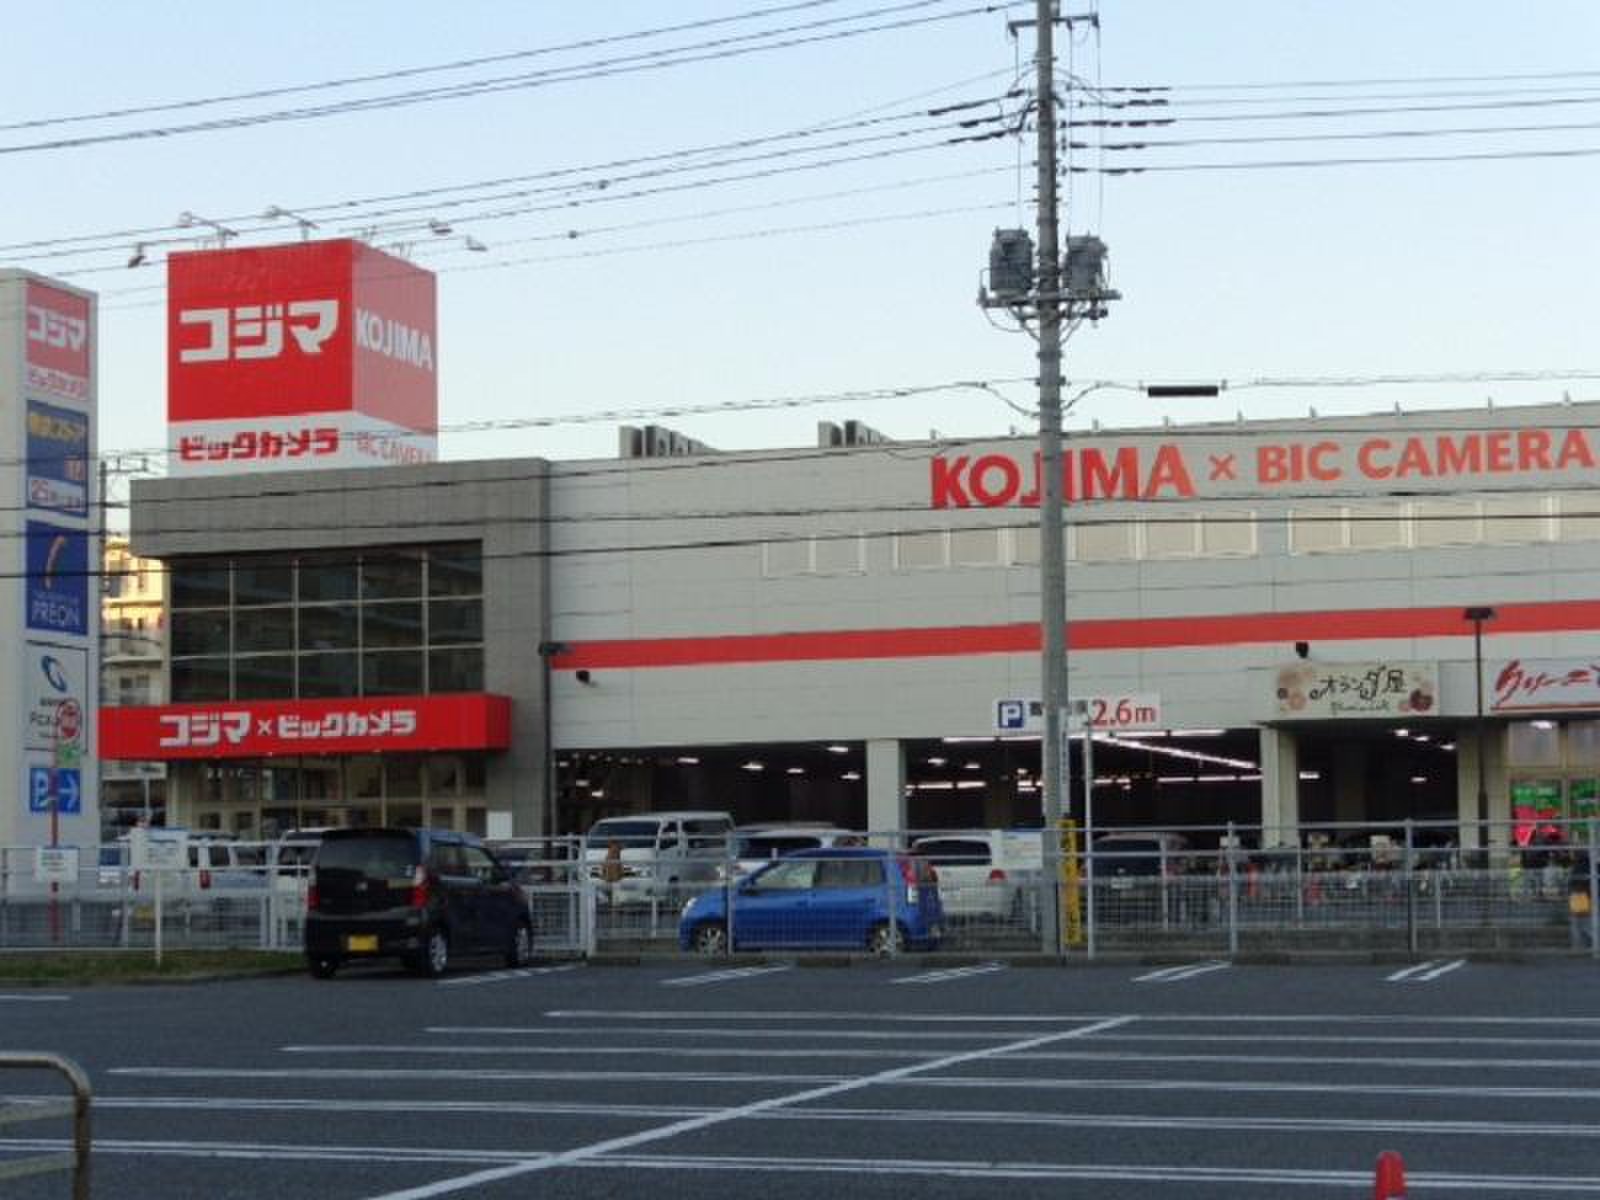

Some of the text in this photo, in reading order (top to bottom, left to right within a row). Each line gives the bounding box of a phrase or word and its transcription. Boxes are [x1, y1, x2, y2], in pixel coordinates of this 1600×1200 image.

[28, 305, 87, 351] コジマ
[180, 300, 339, 363] コジマ
[355, 309, 433, 371] KOJIMA
[180, 428, 339, 462] ビックカメラ
[930, 444, 1195, 508] KOJIMA
[1256, 441, 1341, 484] BIC
[1357, 429, 1594, 479] CAMERA
[1002, 704, 1021, 727] P
